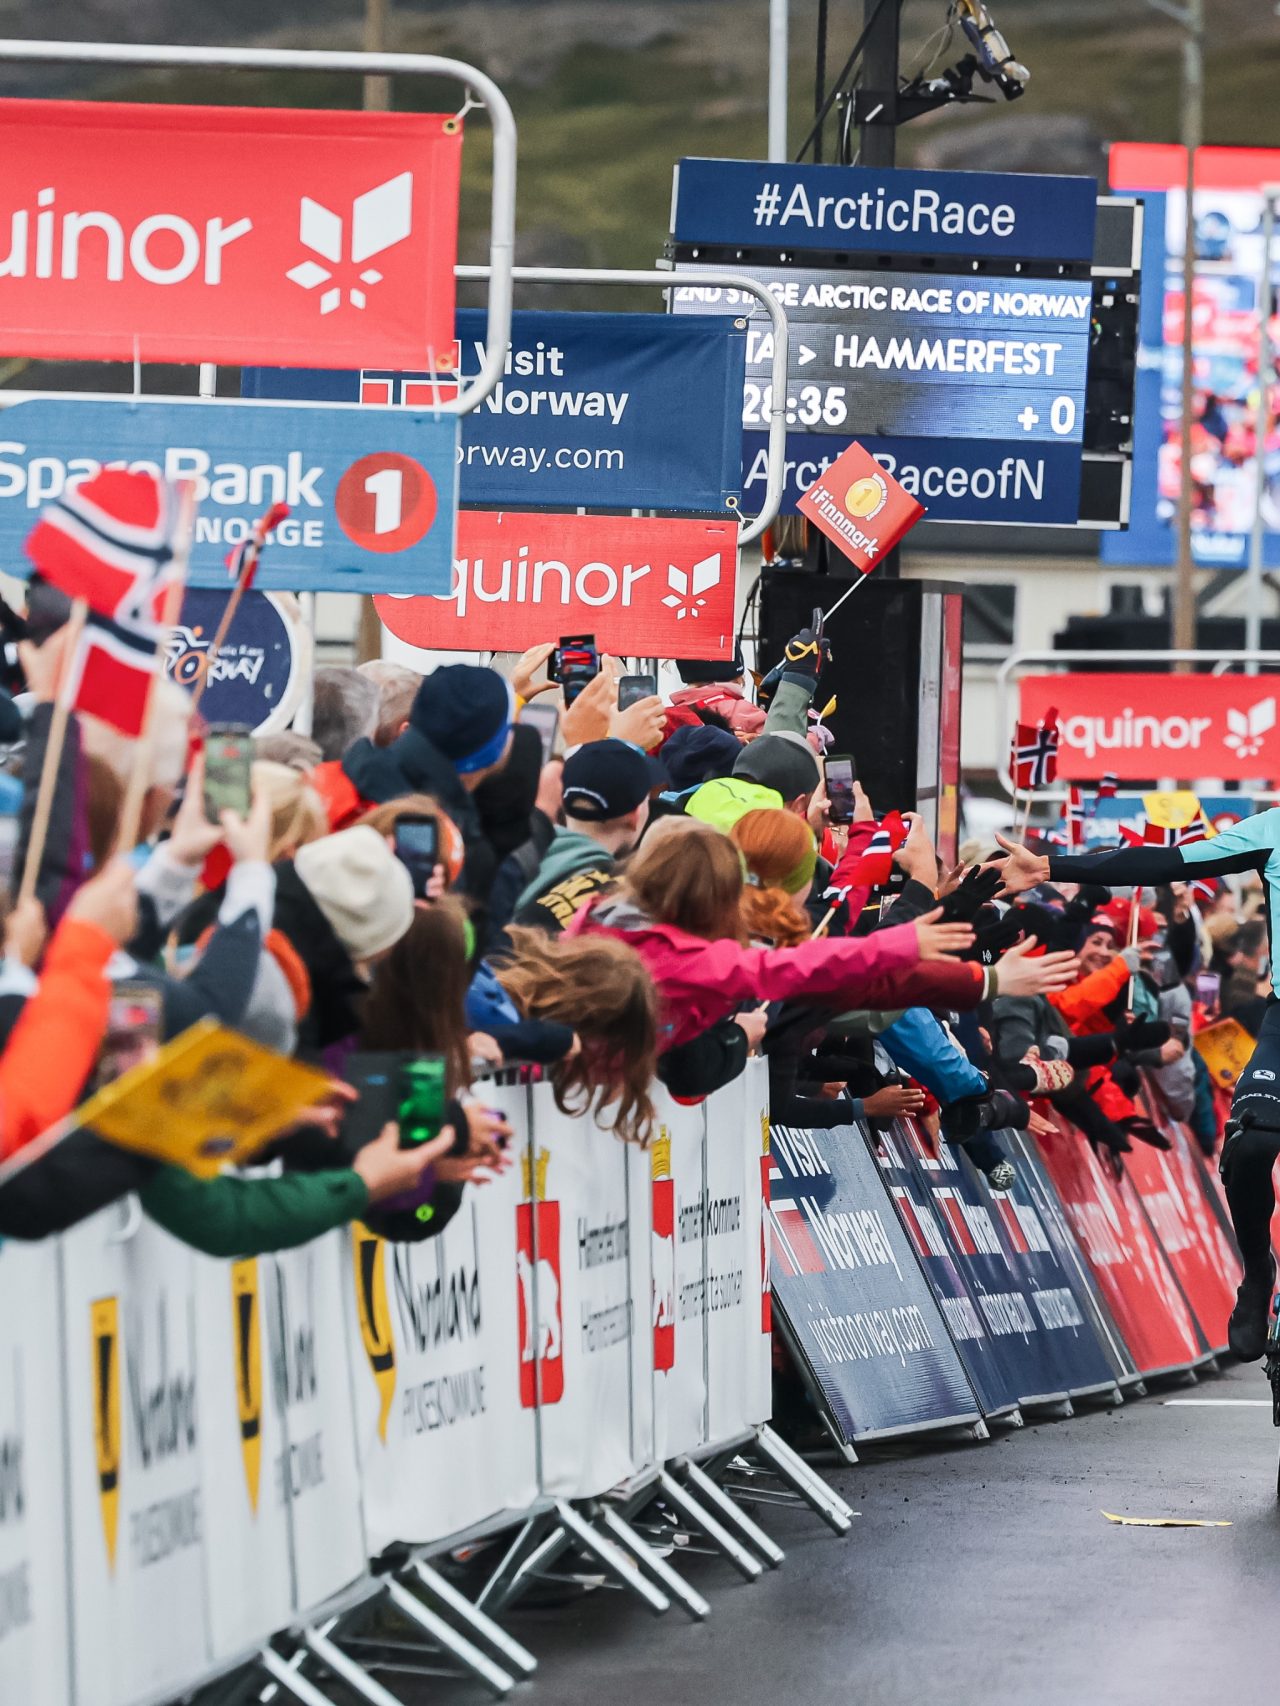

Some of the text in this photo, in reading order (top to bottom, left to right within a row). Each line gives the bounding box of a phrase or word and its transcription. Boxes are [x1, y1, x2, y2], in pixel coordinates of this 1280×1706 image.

[753, 182, 1016, 236] #ArcticRace
[801, 283, 887, 311] ARCTIC
[891, 287, 952, 313] RACE
[956, 290, 990, 314] OF
[992, 292, 1091, 318] NORWAY
[834, 334, 1062, 376] HAMMERFEST
[473, 382, 629, 425] Norway
[0, 441, 324, 508] SpBank
[365, 469, 402, 534] 1
[195, 517, 324, 547] NOGE
[387, 545, 651, 618] quinor
[800, 1195, 904, 1282] Norway
[808, 1302, 935, 1368] visitnorway.com
